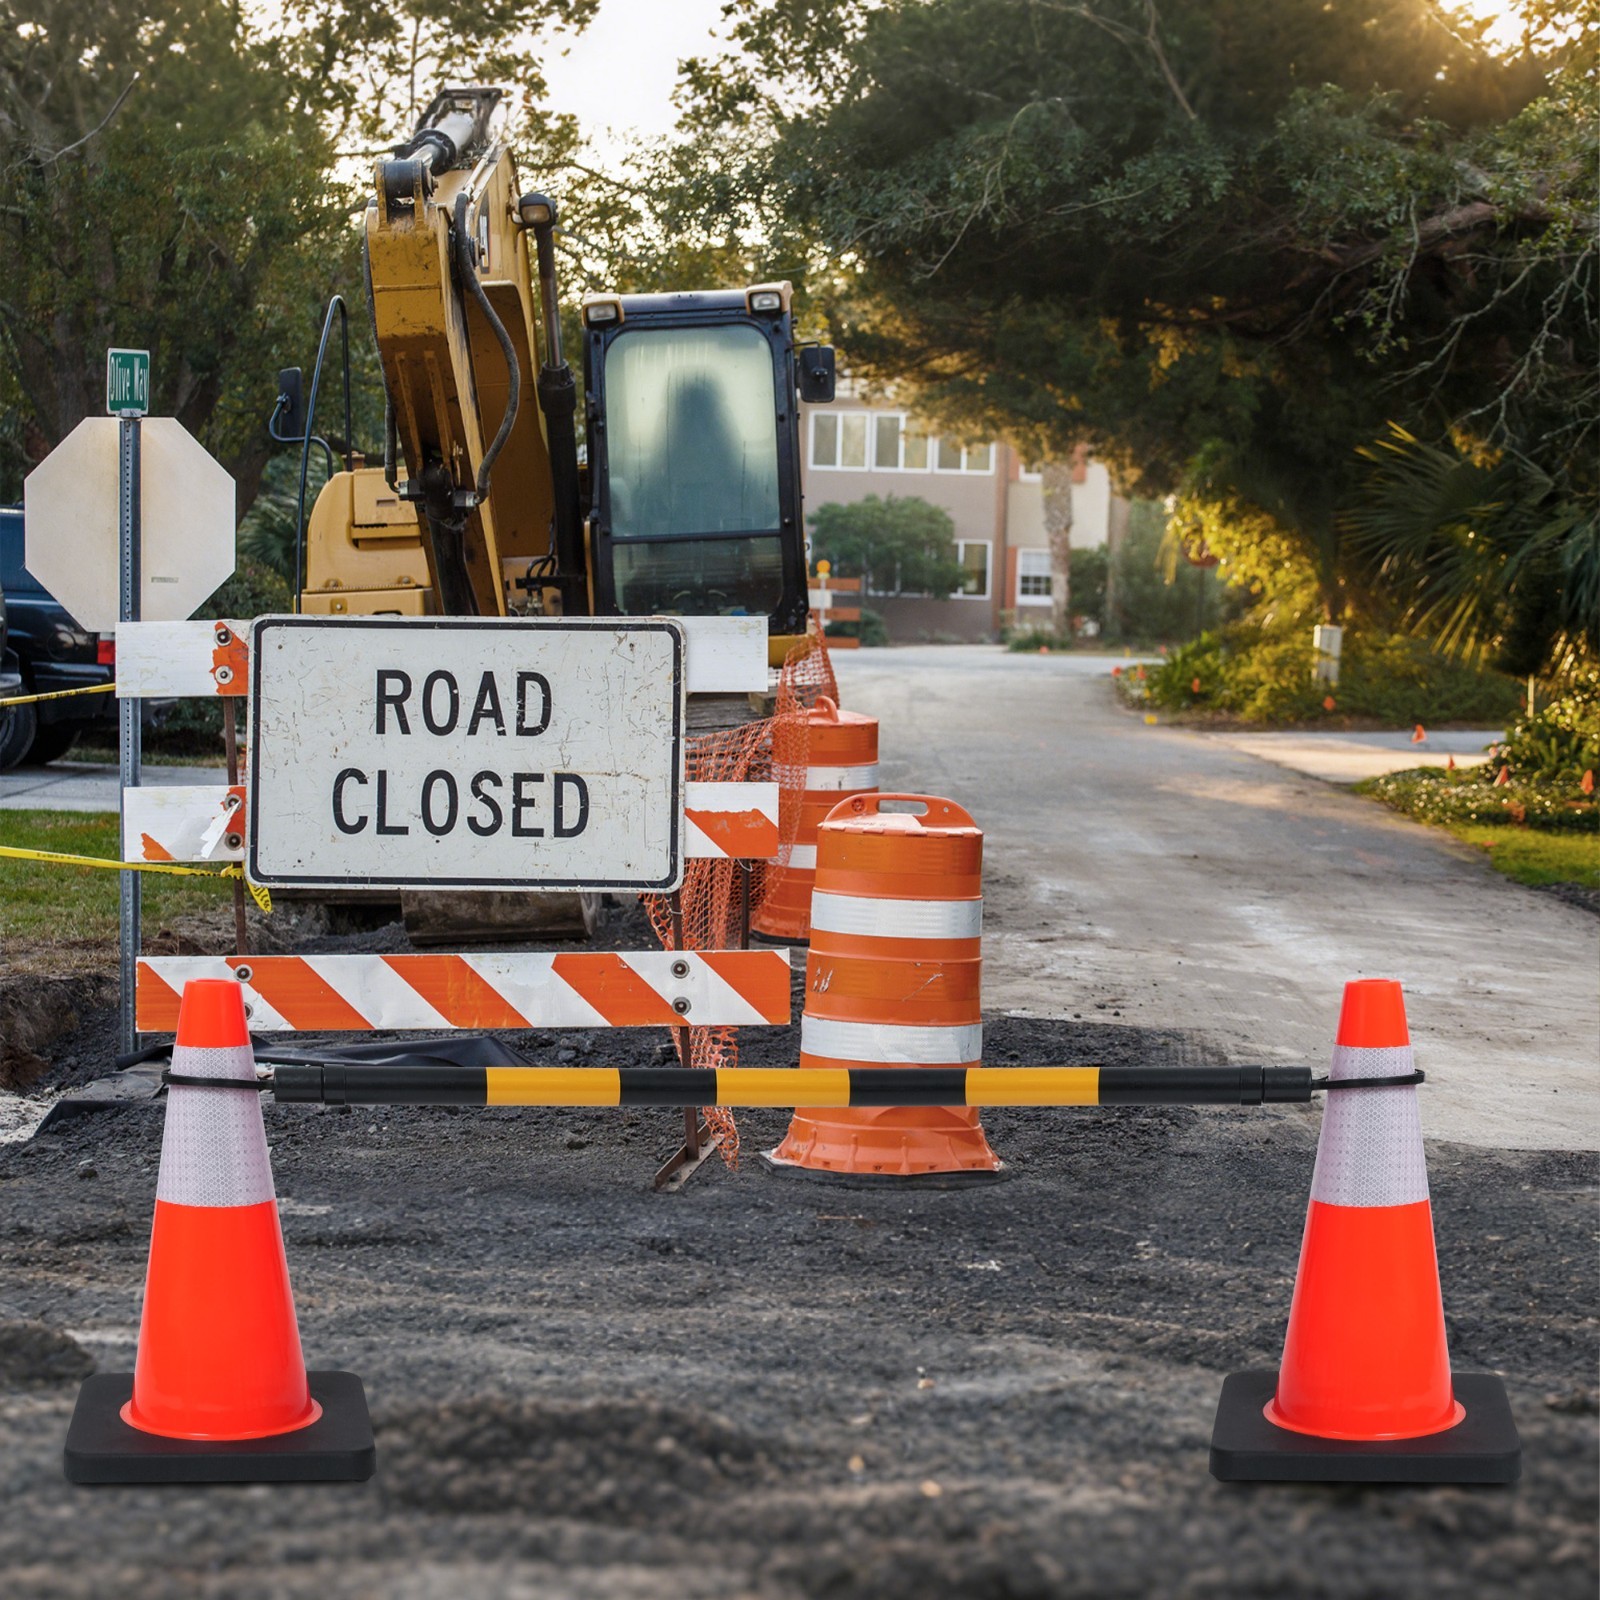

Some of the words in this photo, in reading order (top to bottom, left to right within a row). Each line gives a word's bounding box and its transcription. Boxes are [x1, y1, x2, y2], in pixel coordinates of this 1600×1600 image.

[109, 356, 131, 402] Olive
[133, 357, 148, 408] Way
[376, 669, 552, 737] ROAD
[332, 767, 590, 838] CLOSED
